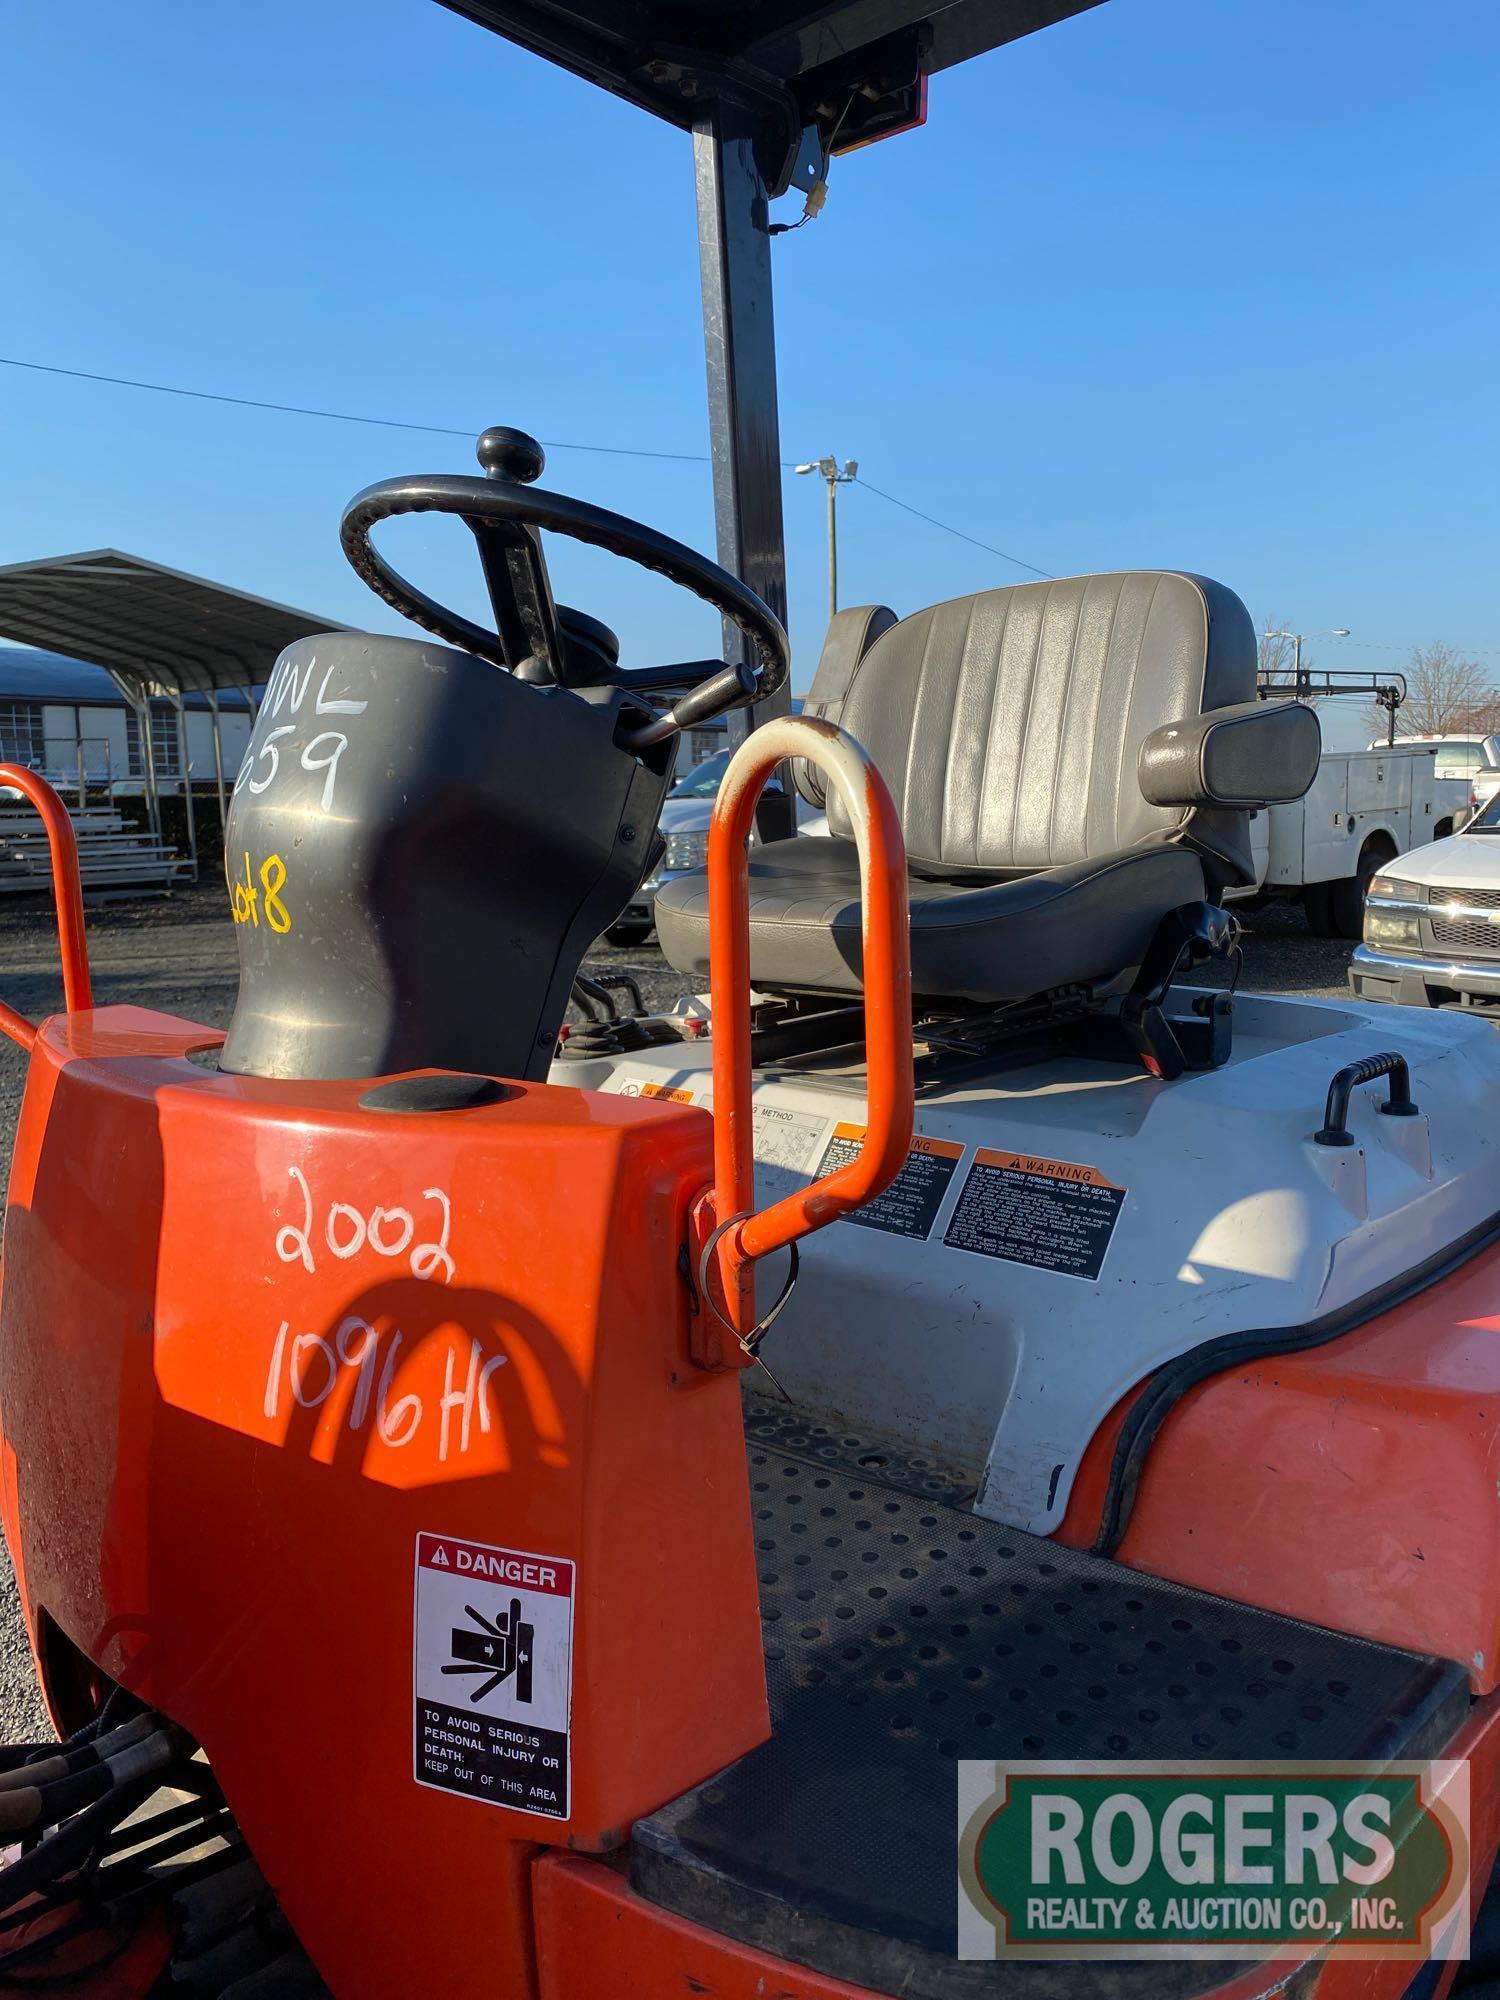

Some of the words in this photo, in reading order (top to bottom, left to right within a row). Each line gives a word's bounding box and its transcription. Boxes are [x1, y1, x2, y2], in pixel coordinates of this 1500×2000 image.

[760, 1108, 794, 1121] METHOD
[984, 1167, 1001, 1175] AVOID
[1002, 1170, 1025, 1180] SERIOUS
[1026, 1175, 1056, 1186] PERSONAL
[1057, 1181, 1078, 1190] INJURY
[1026, 1160, 1092, 1182] WARNING
[275, 1166, 456, 1284] 2002
[263, 1316, 423, 1447] 1096
[438, 1337, 509, 1462] Hr
[456, 1549, 556, 1588] DANGER
[424, 1709, 440, 1722] TO
[447, 1716, 480, 1734] AVOID
[488, 1726, 540, 1748] SERIOUS
[424, 1726, 486, 1752] PERSONAL
[492, 1744, 536, 1764] INJURY
[542, 1756, 559, 1769] OR
[424, 1742, 465, 1763] DEATH:
[424, 1758, 448, 1774] KEEP
[454, 1766, 474, 1781] OUT
[480, 1774, 494, 1786] OF
[500, 1780, 523, 1794] THIS
[530, 1787, 557, 1802] AREA
